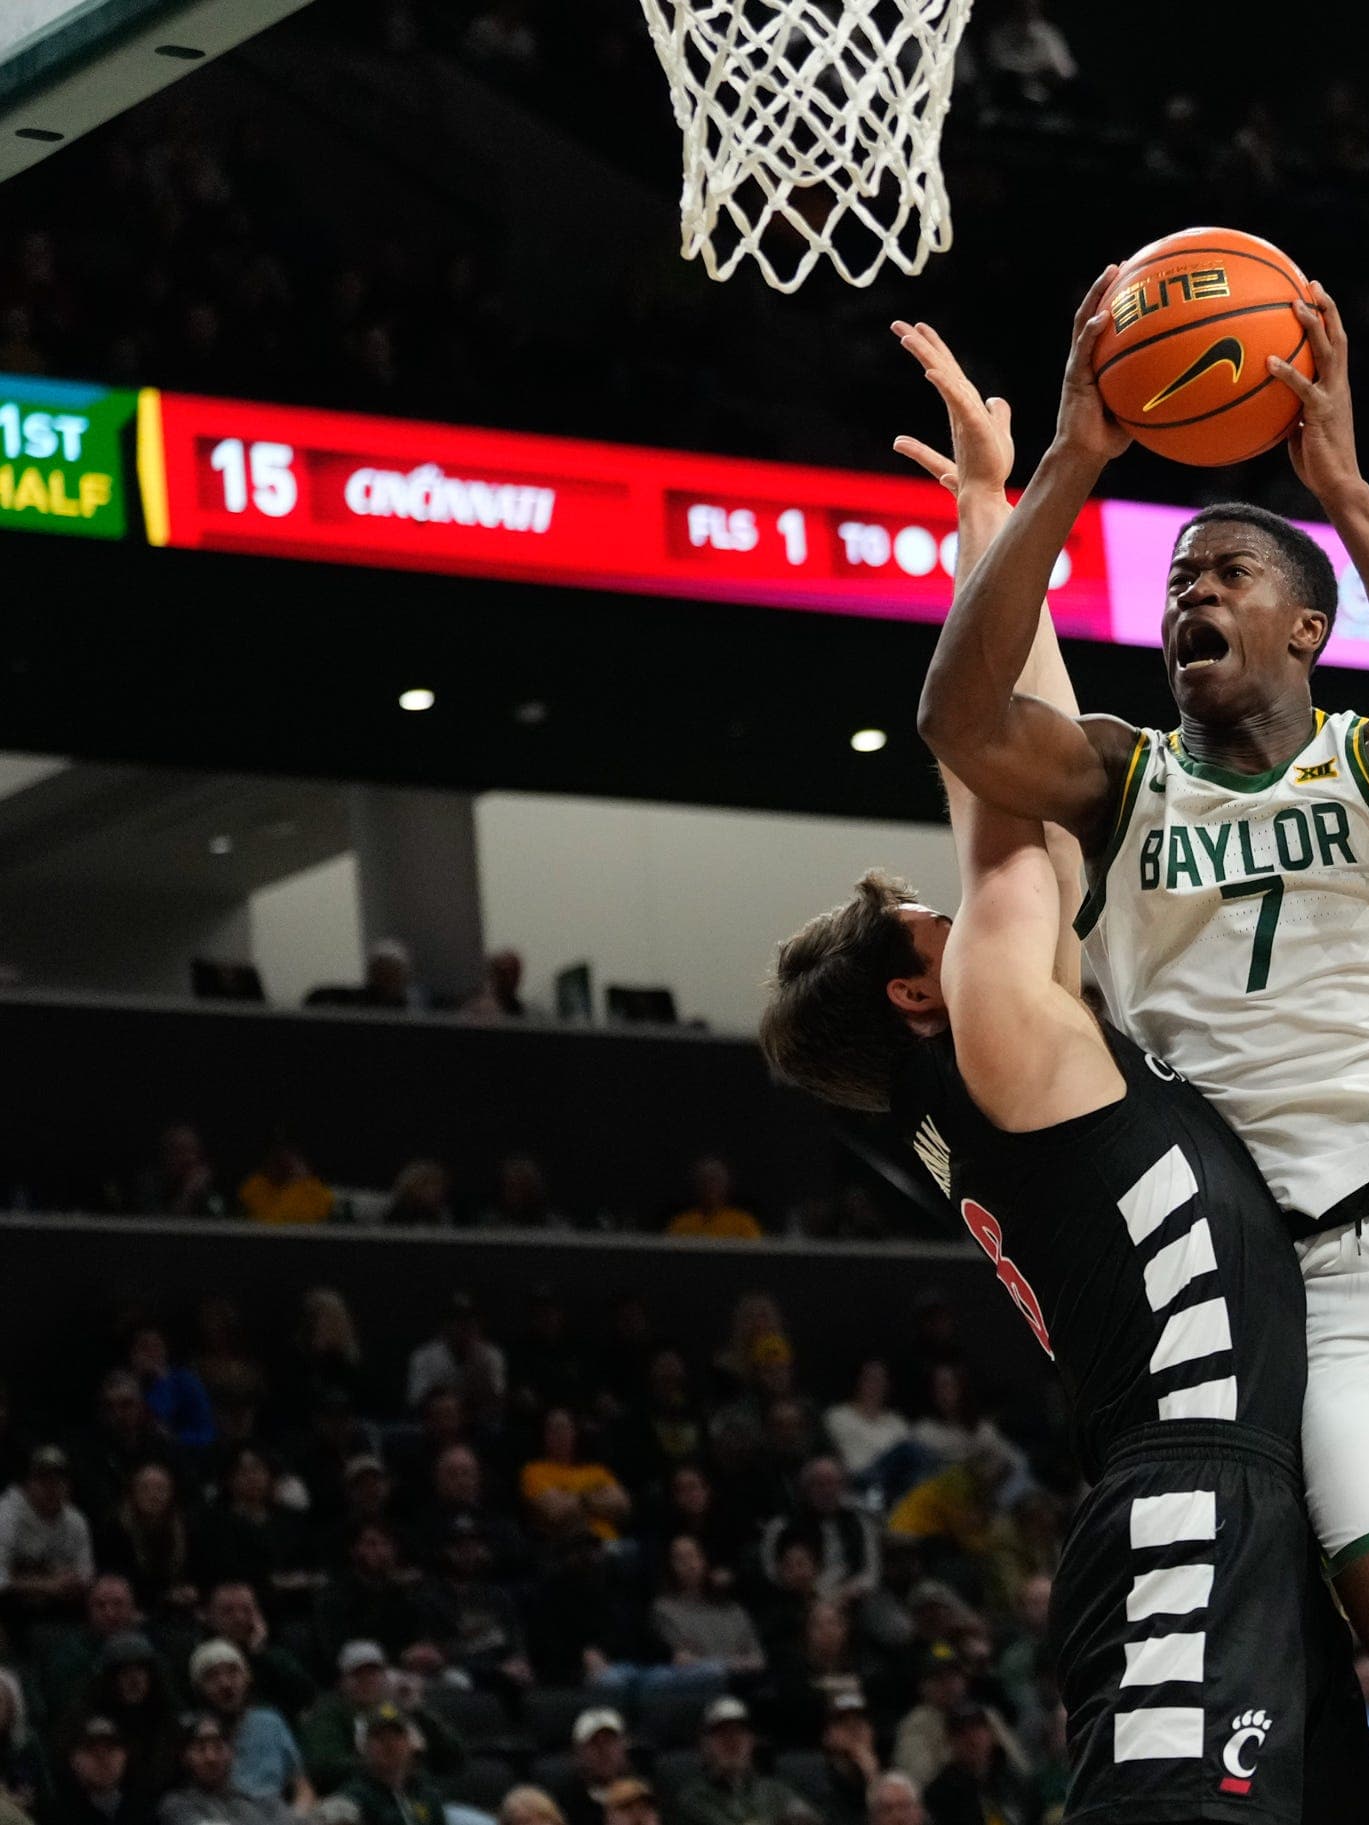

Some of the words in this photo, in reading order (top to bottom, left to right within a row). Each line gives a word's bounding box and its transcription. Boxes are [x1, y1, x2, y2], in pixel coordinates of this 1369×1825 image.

[1111, 267, 1231, 336] ELITE
[0, 402, 89, 462] 1ST
[211, 438, 298, 517] 15
[688, 503, 760, 552] FLS
[777, 508, 808, 566] 1
[1140, 802, 1357, 891] BAYLOR
[1220, 875, 1285, 994] 7
